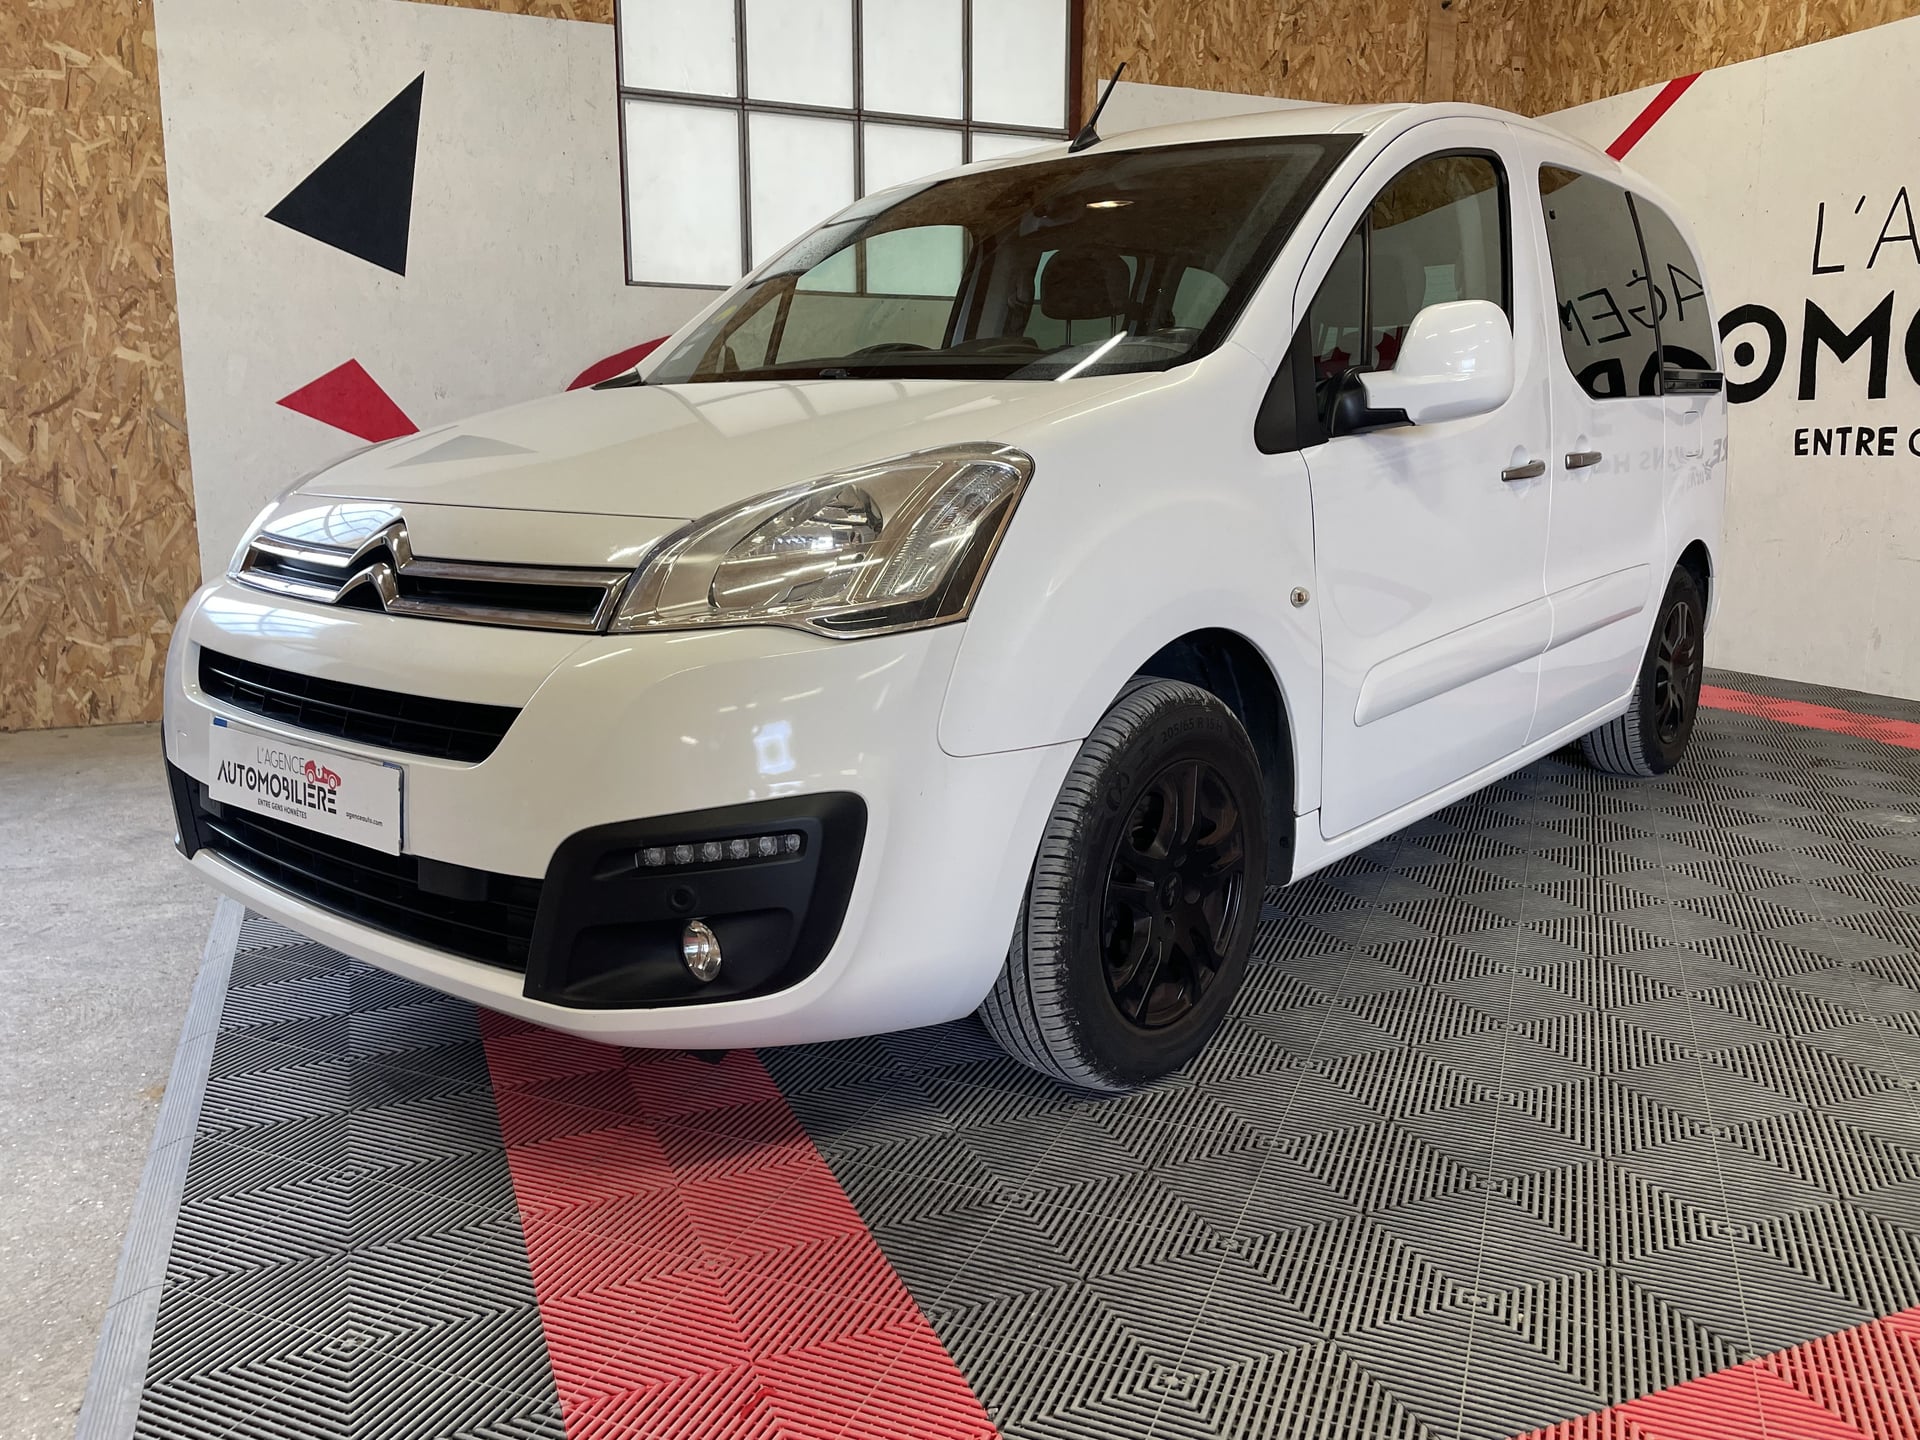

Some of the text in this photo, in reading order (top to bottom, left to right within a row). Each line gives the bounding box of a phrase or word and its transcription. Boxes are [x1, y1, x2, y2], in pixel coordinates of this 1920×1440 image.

[1794, 426, 1898, 456] ENTRE
[1161, 718, 1194, 744] 205/65
[256, 746, 306, 776] L'AGENCE
[257, 798, 271, 809] ENTRE
[271, 802, 283, 812] GENS
